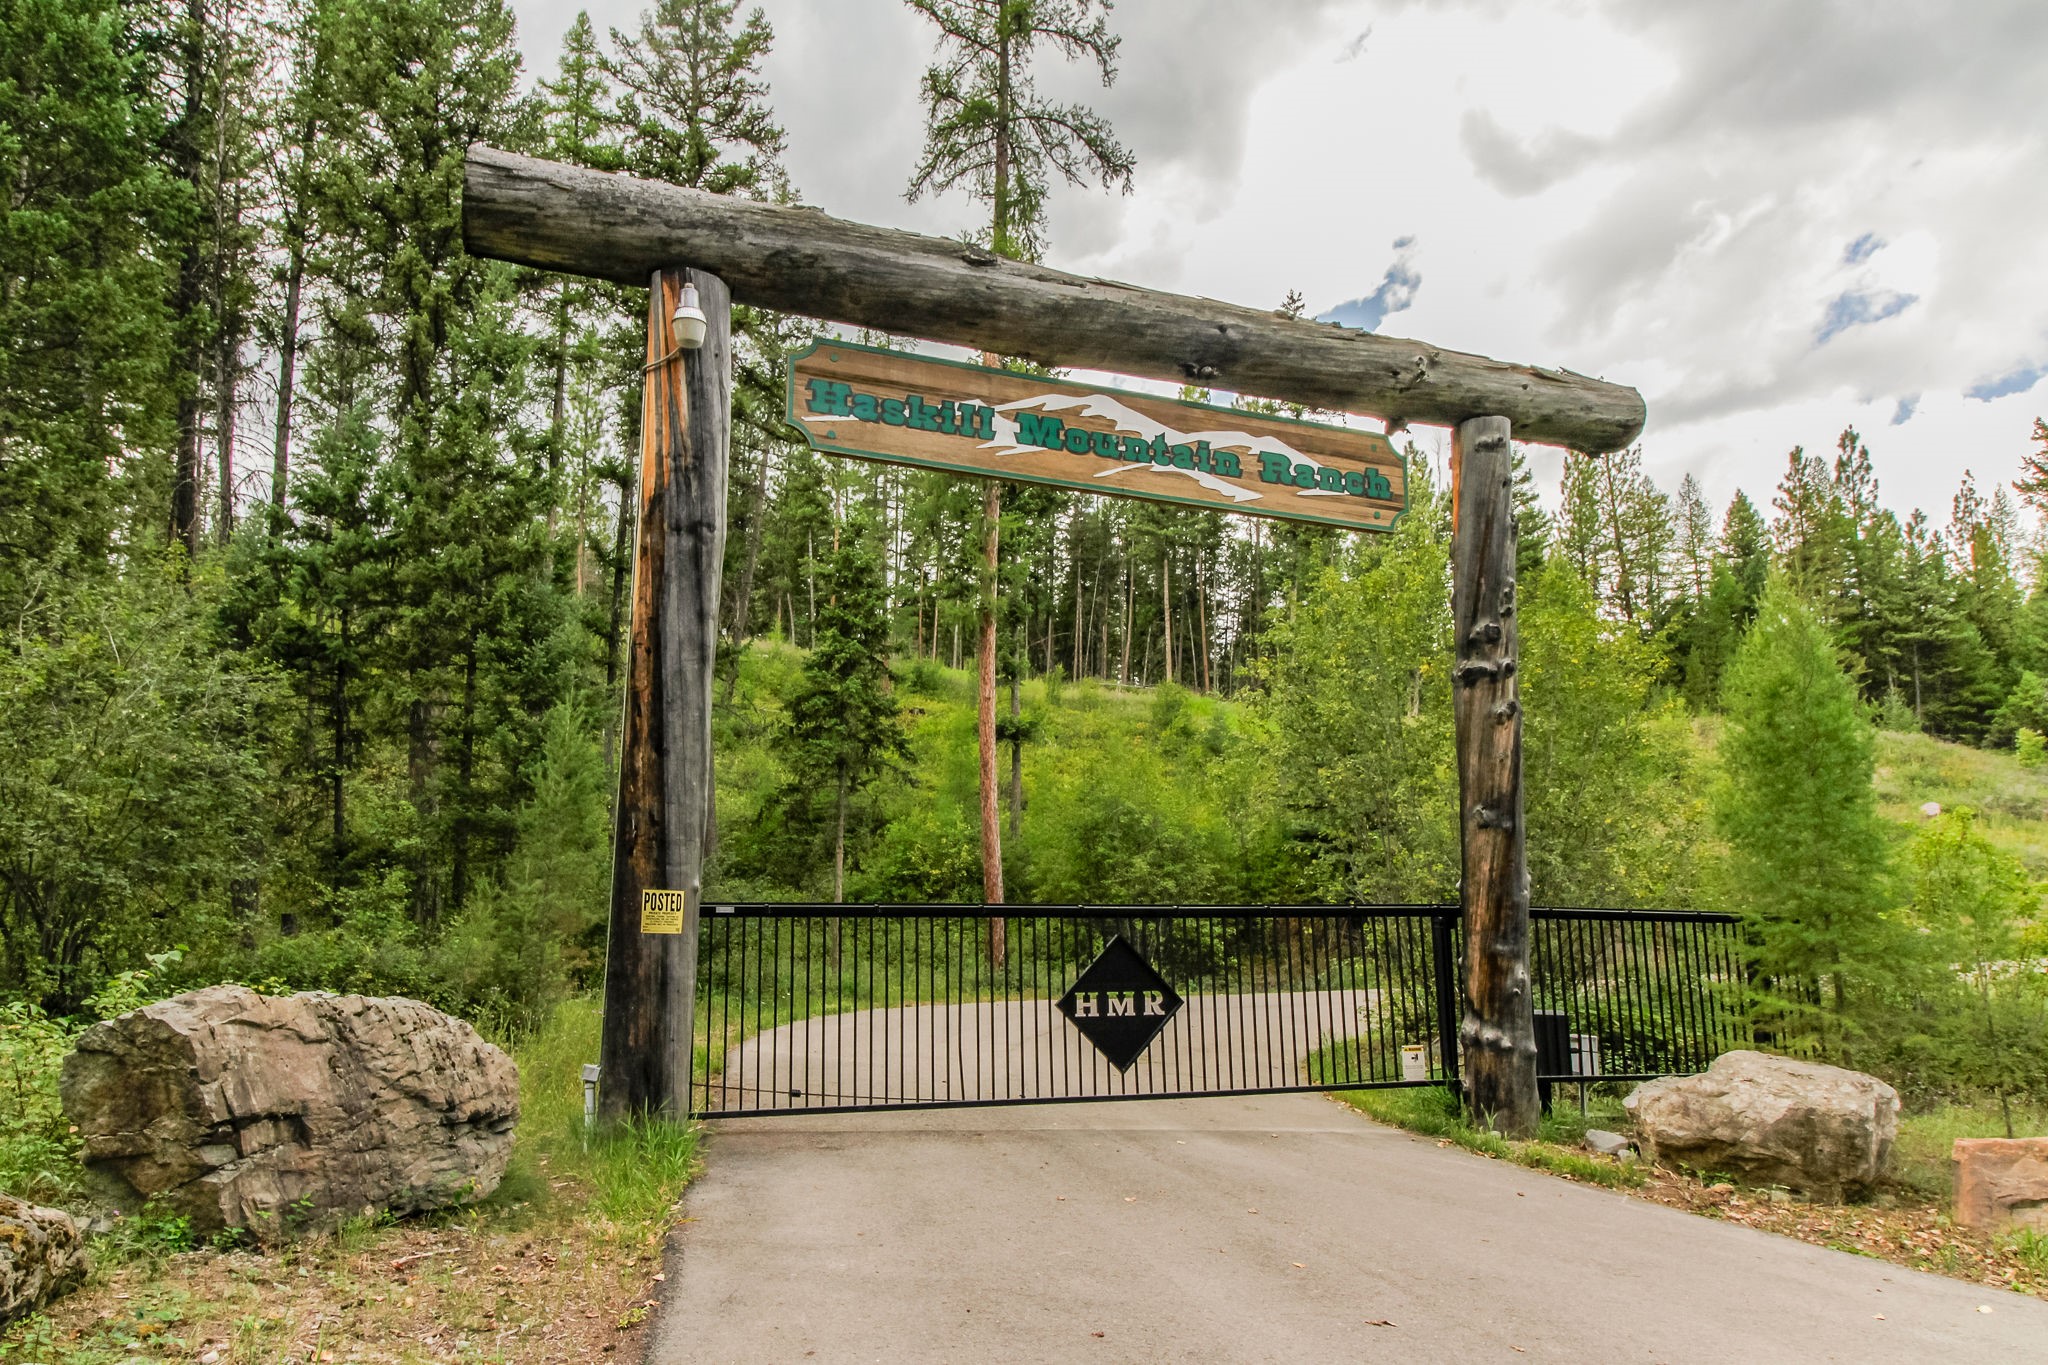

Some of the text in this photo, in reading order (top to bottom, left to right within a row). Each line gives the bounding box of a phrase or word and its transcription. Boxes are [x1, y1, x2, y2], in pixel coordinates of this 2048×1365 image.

[805, 378, 1393, 500] Haskill Mountain Ranch
[644, 892, 682, 912] POSTED
[1074, 990, 1166, 1017] HMR
